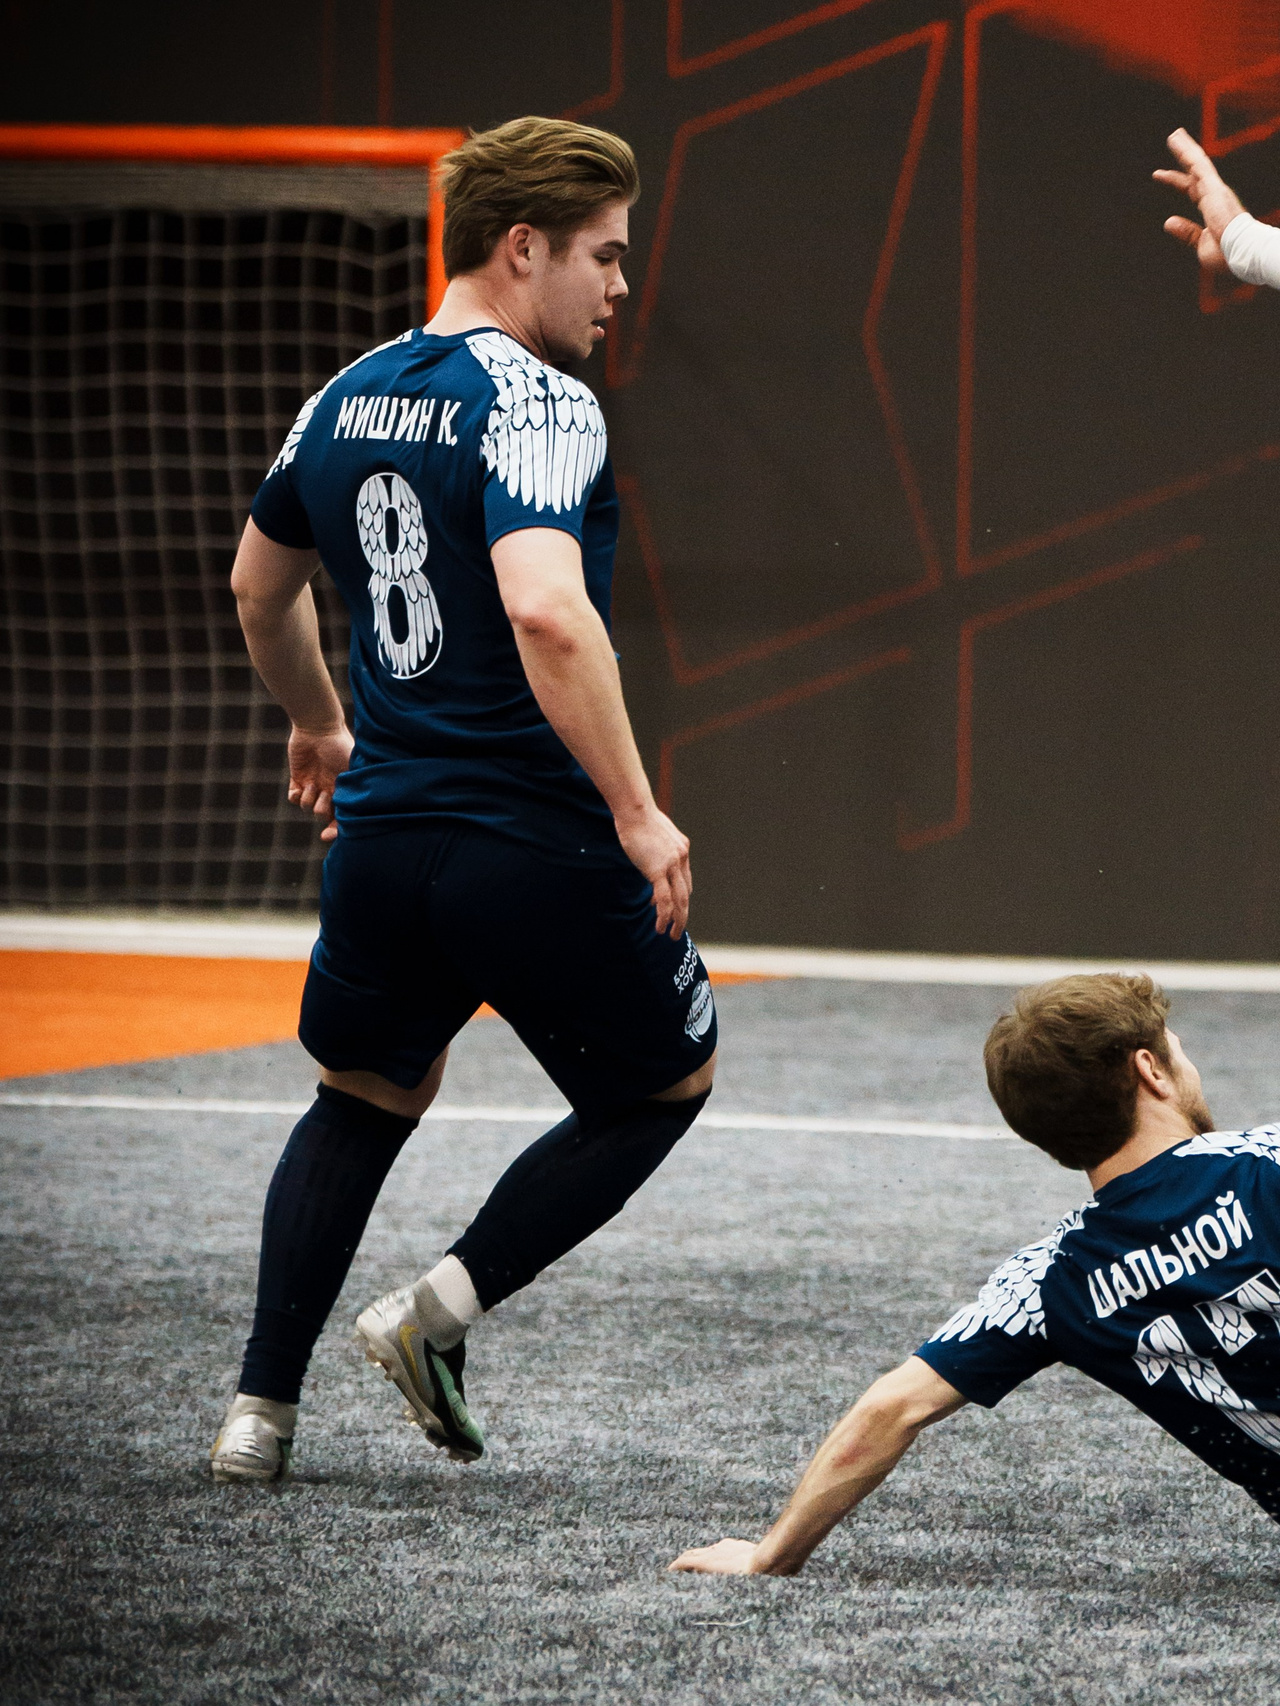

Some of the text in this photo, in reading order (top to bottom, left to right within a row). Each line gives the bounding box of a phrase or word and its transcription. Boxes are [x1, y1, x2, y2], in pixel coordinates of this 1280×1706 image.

[333, 396, 462, 446] МИШИН К.
[356, 472, 443, 680] 8
[1087, 1190, 1253, 1318] ШАЛЬНОЙ
